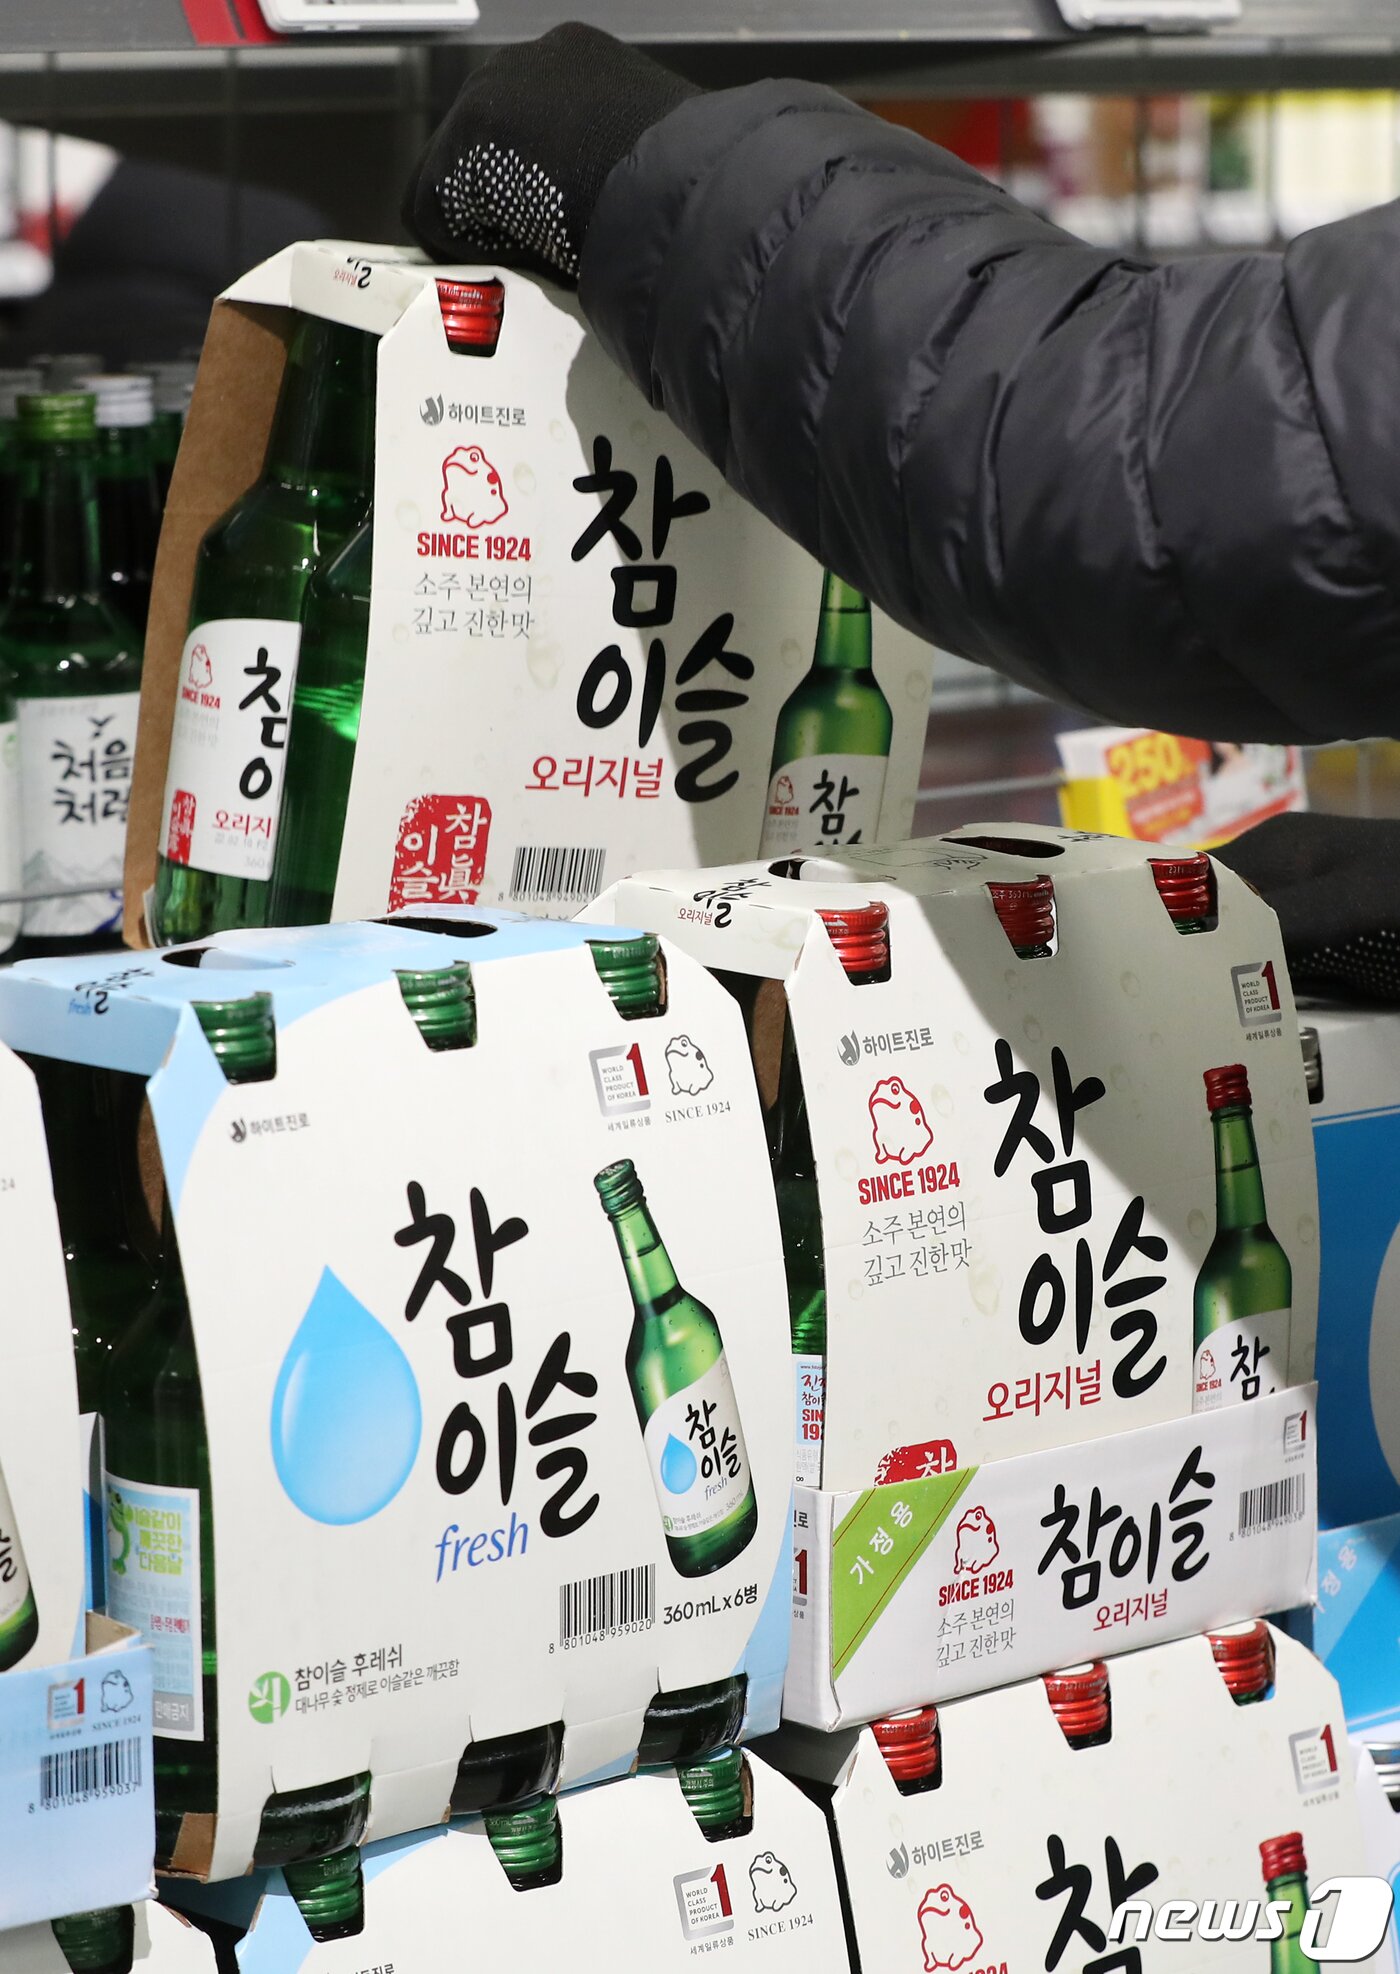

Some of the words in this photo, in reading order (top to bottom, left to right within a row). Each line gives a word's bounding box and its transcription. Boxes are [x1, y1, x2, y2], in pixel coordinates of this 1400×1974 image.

[447, 402, 528, 428] 하이트진로
[416, 532, 479, 559] SINCE
[484, 535, 532, 562] 1924
[570, 435, 711, 628] 참
[413, 573, 462, 599] 소주
[465, 572, 533, 604] 본연의
[411, 606, 458, 636] 깊고
[200, 691, 222, 710] 1924
[576, 612, 755, 803] 이슬
[51, 738, 131, 783] 처음
[524, 755, 664, 799] 오리지널
[808, 768, 861, 836] 참
[677, 907, 714, 927] 오리지널
[1241, 980, 1261, 989] WORLD
[1242, 989, 1259, 998] CLASS
[1244, 996, 1269, 1006] PRODUCT
[1261, 960, 1281, 1011] 1
[1253, 1004, 1271, 1012] KOREA
[862, 1027, 935, 1058] 하이트진로
[601, 1064, 624, 1075] WORLD
[603, 1074, 623, 1084] CLASS
[605, 1081, 635, 1093] PRODUCT
[625, 1042, 650, 1097] 1
[616, 1090, 637, 1100] KOREA
[664, 1105, 703, 1124] SINCE
[706, 1100, 732, 1117] 1924
[249, 1112, 311, 1137] 하이트진로
[982, 1037, 1107, 1235] 참
[857, 1172, 914, 1206] SINCE
[917, 1161, 961, 1194] 1924
[861, 1213, 904, 1248] 소주
[907, 1200, 967, 1241] 본연의
[393, 1180, 529, 1379] 참
[863, 1252, 906, 1288] 깊고
[1018, 1195, 1169, 1399] 이슬
[1229, 1333, 1271, 1402] 참
[981, 1358, 1101, 1422] 오리지널
[435, 1330, 601, 1539] 이슬
[684, 1399, 718, 1451] 참
[801, 1423, 824, 1441] 19
[1299, 1409, 1308, 1442] 1
[700, 1426, 743, 1480] 이슬
[703, 1476, 729, 1501] fresh
[849, 1500, 915, 1586] 가정용
[1037, 1445, 1216, 1610] 참이슬
[434, 1511, 530, 1584] fresh
[794, 1548, 808, 1596] 1
[938, 1580, 980, 1607] SINCE
[982, 1569, 1014, 1594] 1924
[936, 1612, 969, 1639] 소주
[969, 1598, 1015, 1628] 본연의
[1092, 1587, 1169, 1633] 오리지널
[548, 1642, 556, 1655] 8
[563, 1630, 606, 1651] 801048
[610, 1618, 653, 1639] 959020
[294, 1658, 348, 1692] 참이슬
[351, 1643, 403, 1678] 후레쉬
[936, 1643, 967, 1669] 깊고
[73, 1677, 86, 1716] 1
[294, 1690, 330, 1715] 대나무
[331, 1688, 344, 1707] 숯
[345, 1680, 379, 1703] 정제로
[380, 1666, 425, 1693] 이슬같은
[426, 1658, 460, 1682] 깨끗함
[1320, 1723, 1338, 1773] 1
[911, 1829, 985, 1868] 하이트진로
[685, 1887, 709, 1899] WORLD
[687, 1896, 708, 1908] CLASS
[709, 1862, 734, 1918] 1
[688, 1903, 719, 1917] PRODUCT
[690, 1917, 701, 1926] OF
[700, 1912, 721, 1924] KOREA
[747, 1920, 787, 1943] SINCE
[788, 1913, 815, 1931] 1924
[689, 1936, 735, 1956] 세계일류상품
